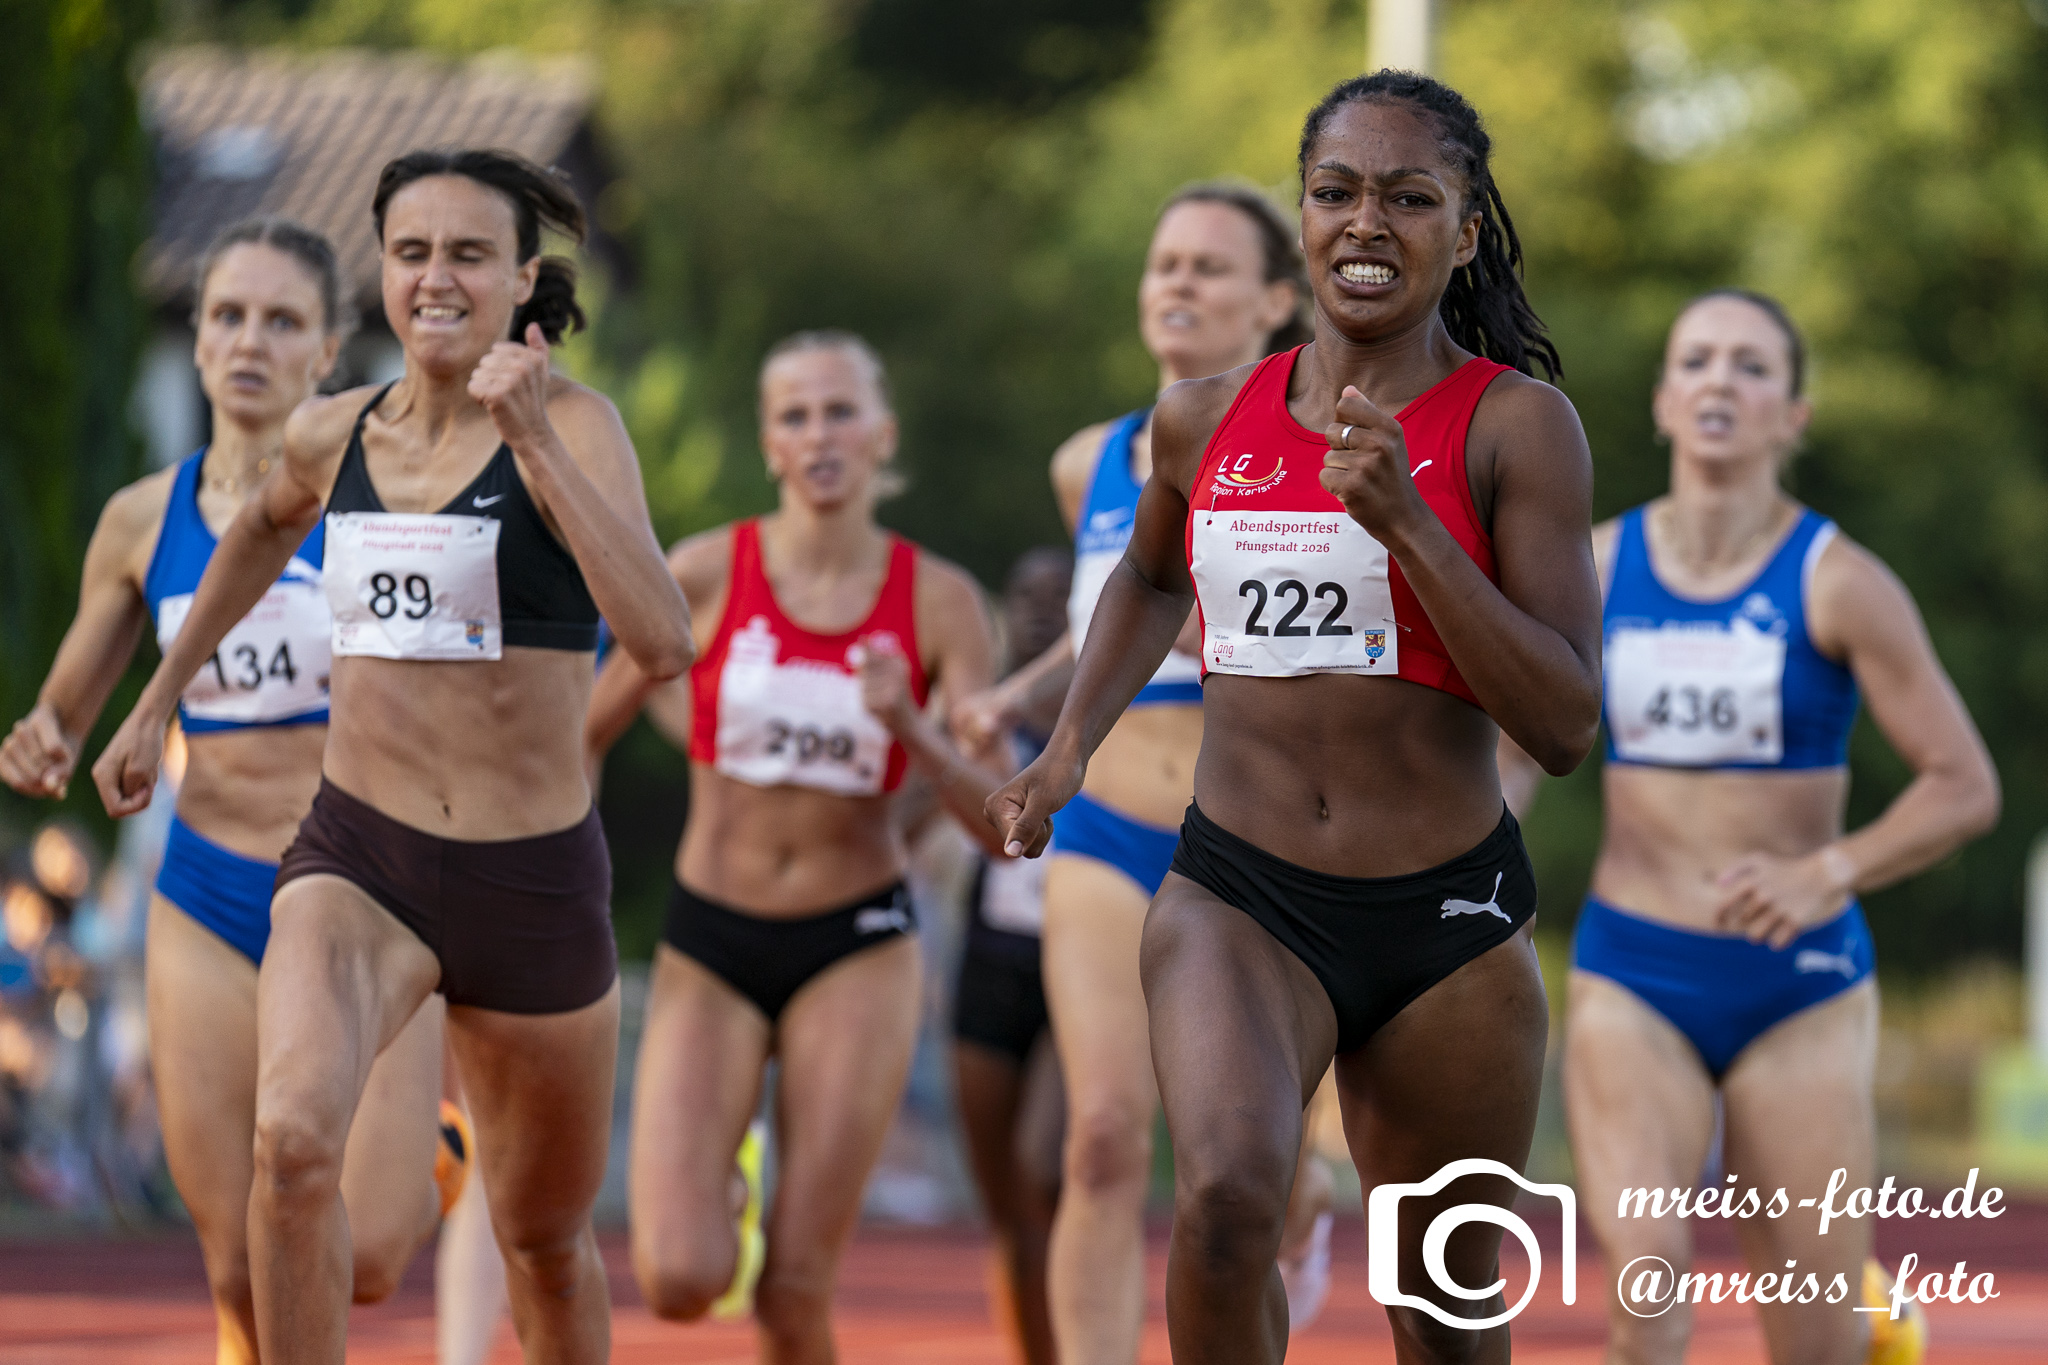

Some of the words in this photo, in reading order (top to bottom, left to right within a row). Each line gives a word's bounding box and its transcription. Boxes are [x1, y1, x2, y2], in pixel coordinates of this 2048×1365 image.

[1209, 482, 1234, 496] Region
[1236, 470, 1288, 496] Karlsruhe
[1229, 519, 1340, 536] Abendsportfest
[1235, 540, 1299, 554] Pfungstadt
[1301, 542, 1330, 553] 2026
[368, 572, 433, 620] 89
[1238, 579, 1354, 637] 222
[207, 638, 297, 691] 134
[1213, 641, 1234, 658] Lang
[1646, 684, 1739, 732] 436
